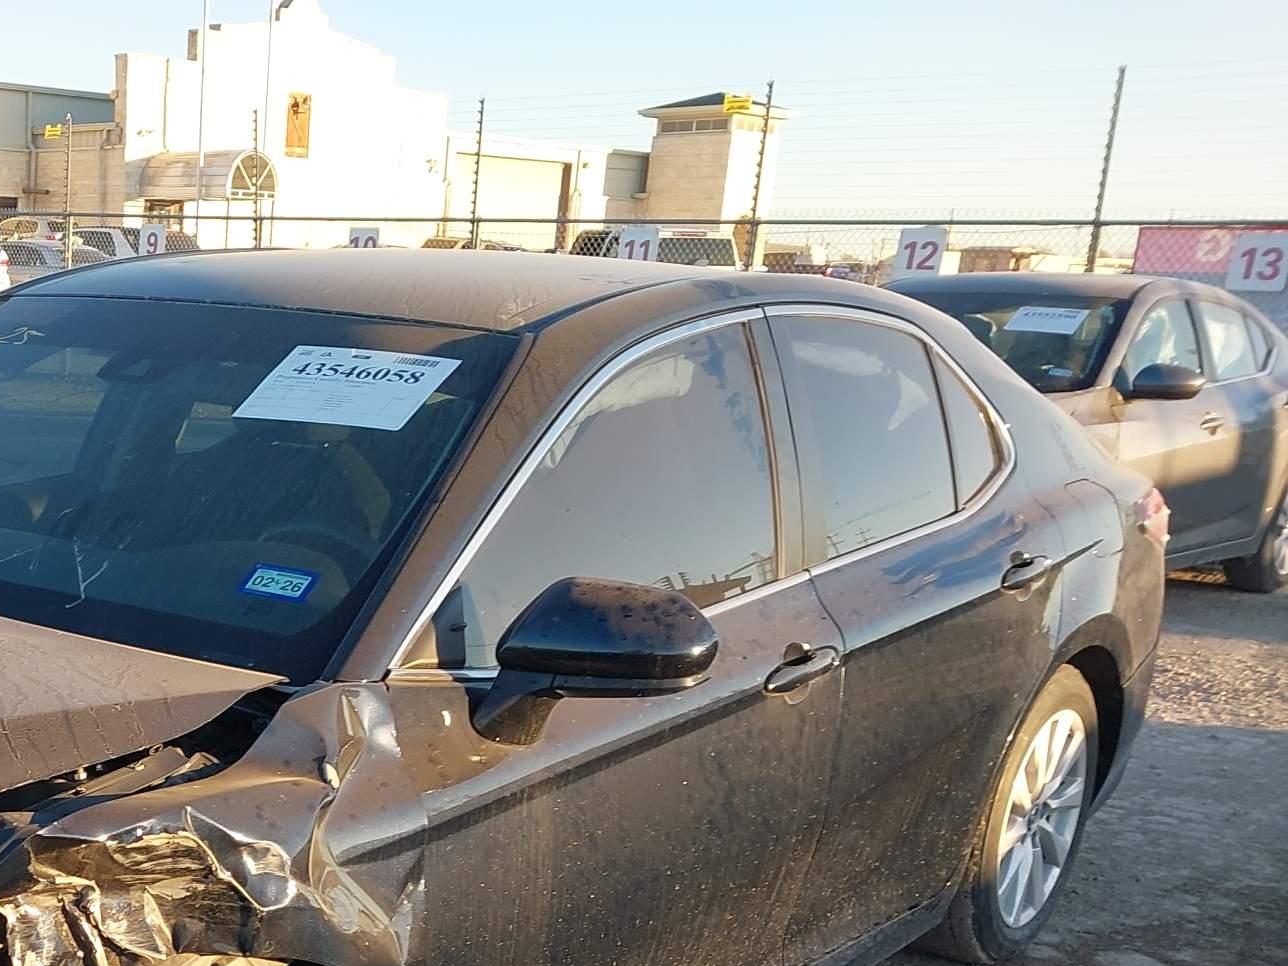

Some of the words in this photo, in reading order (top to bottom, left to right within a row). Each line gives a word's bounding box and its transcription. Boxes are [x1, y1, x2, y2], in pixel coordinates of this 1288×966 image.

[146, 231, 158, 254] 9
[624, 239, 650, 261] 11
[903, 241, 939, 270] 12
[1240, 247, 1284, 281] 13
[292, 361, 426, 385] 43546058
